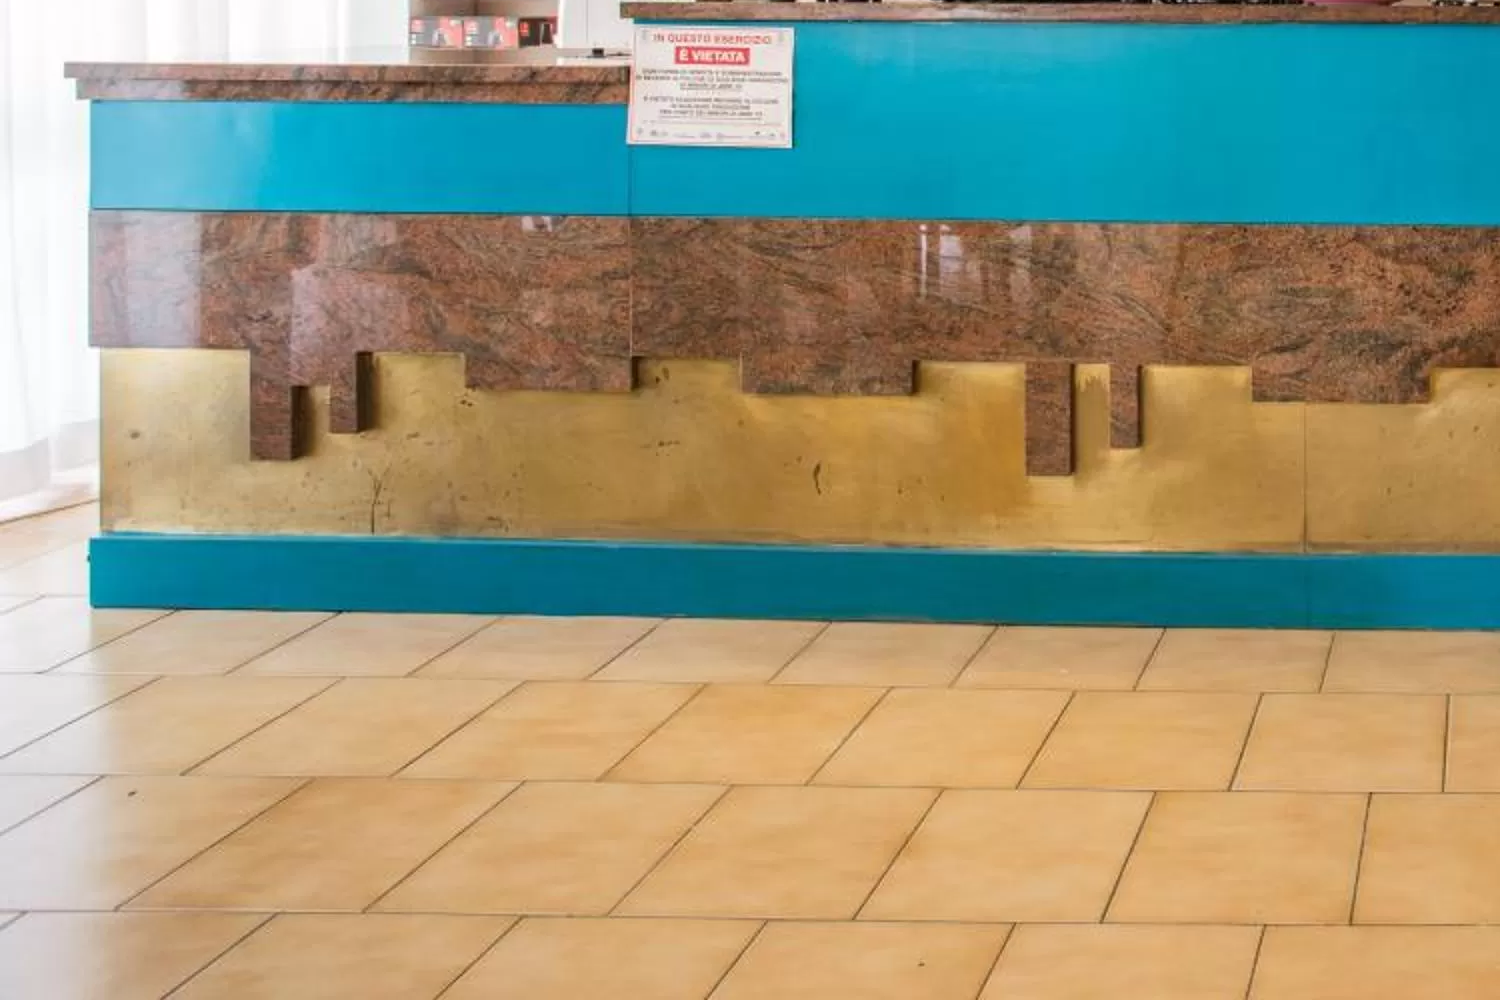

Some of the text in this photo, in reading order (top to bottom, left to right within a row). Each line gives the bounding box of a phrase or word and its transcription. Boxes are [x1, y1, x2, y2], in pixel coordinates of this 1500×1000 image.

[653, 33, 665, 43] IN
[667, 33, 711, 44] QUESTO
[692, 49, 746, 62] VIETATA
